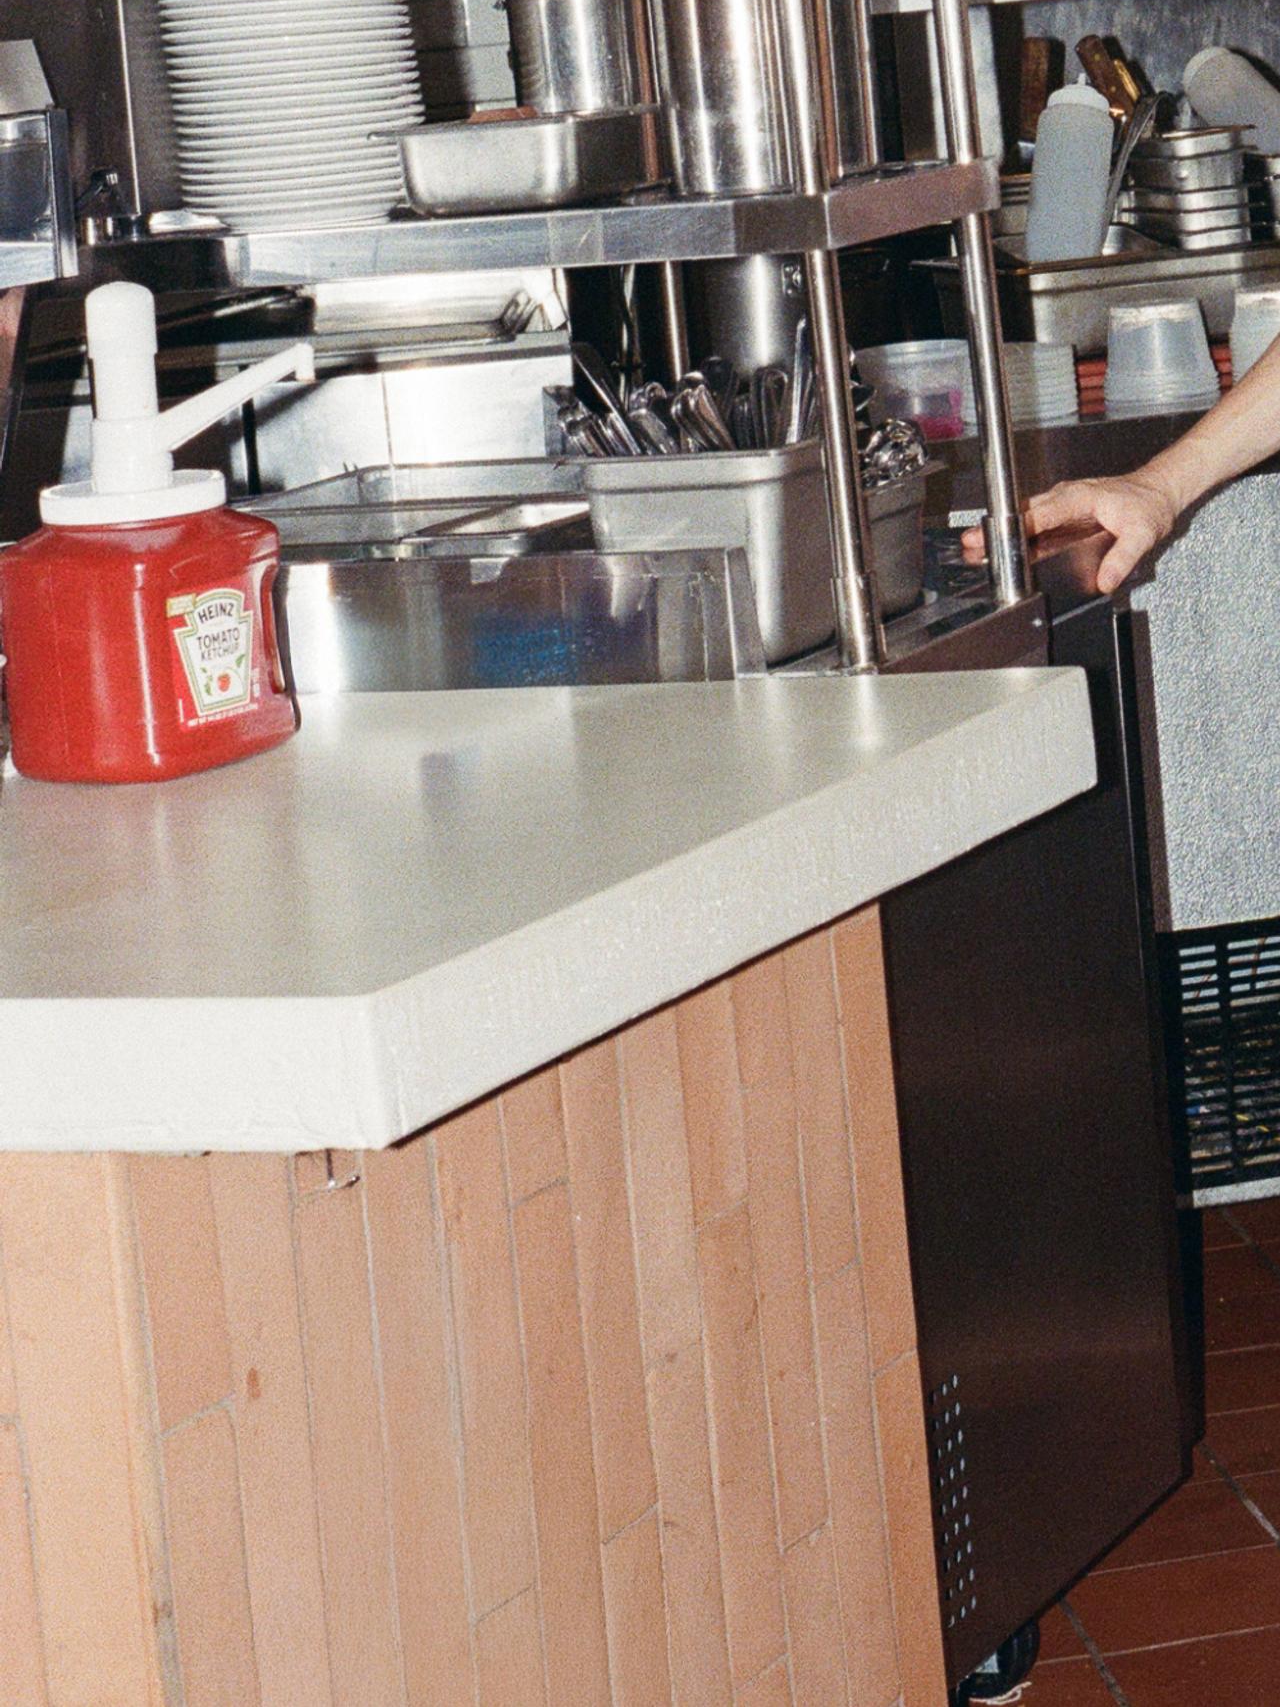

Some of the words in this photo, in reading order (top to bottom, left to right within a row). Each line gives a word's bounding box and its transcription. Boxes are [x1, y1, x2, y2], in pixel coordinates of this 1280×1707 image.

[198, 602, 235, 624] HEINZ
[196, 627, 240, 650] TOMATO
[201, 643, 240, 662] KETCHUP
